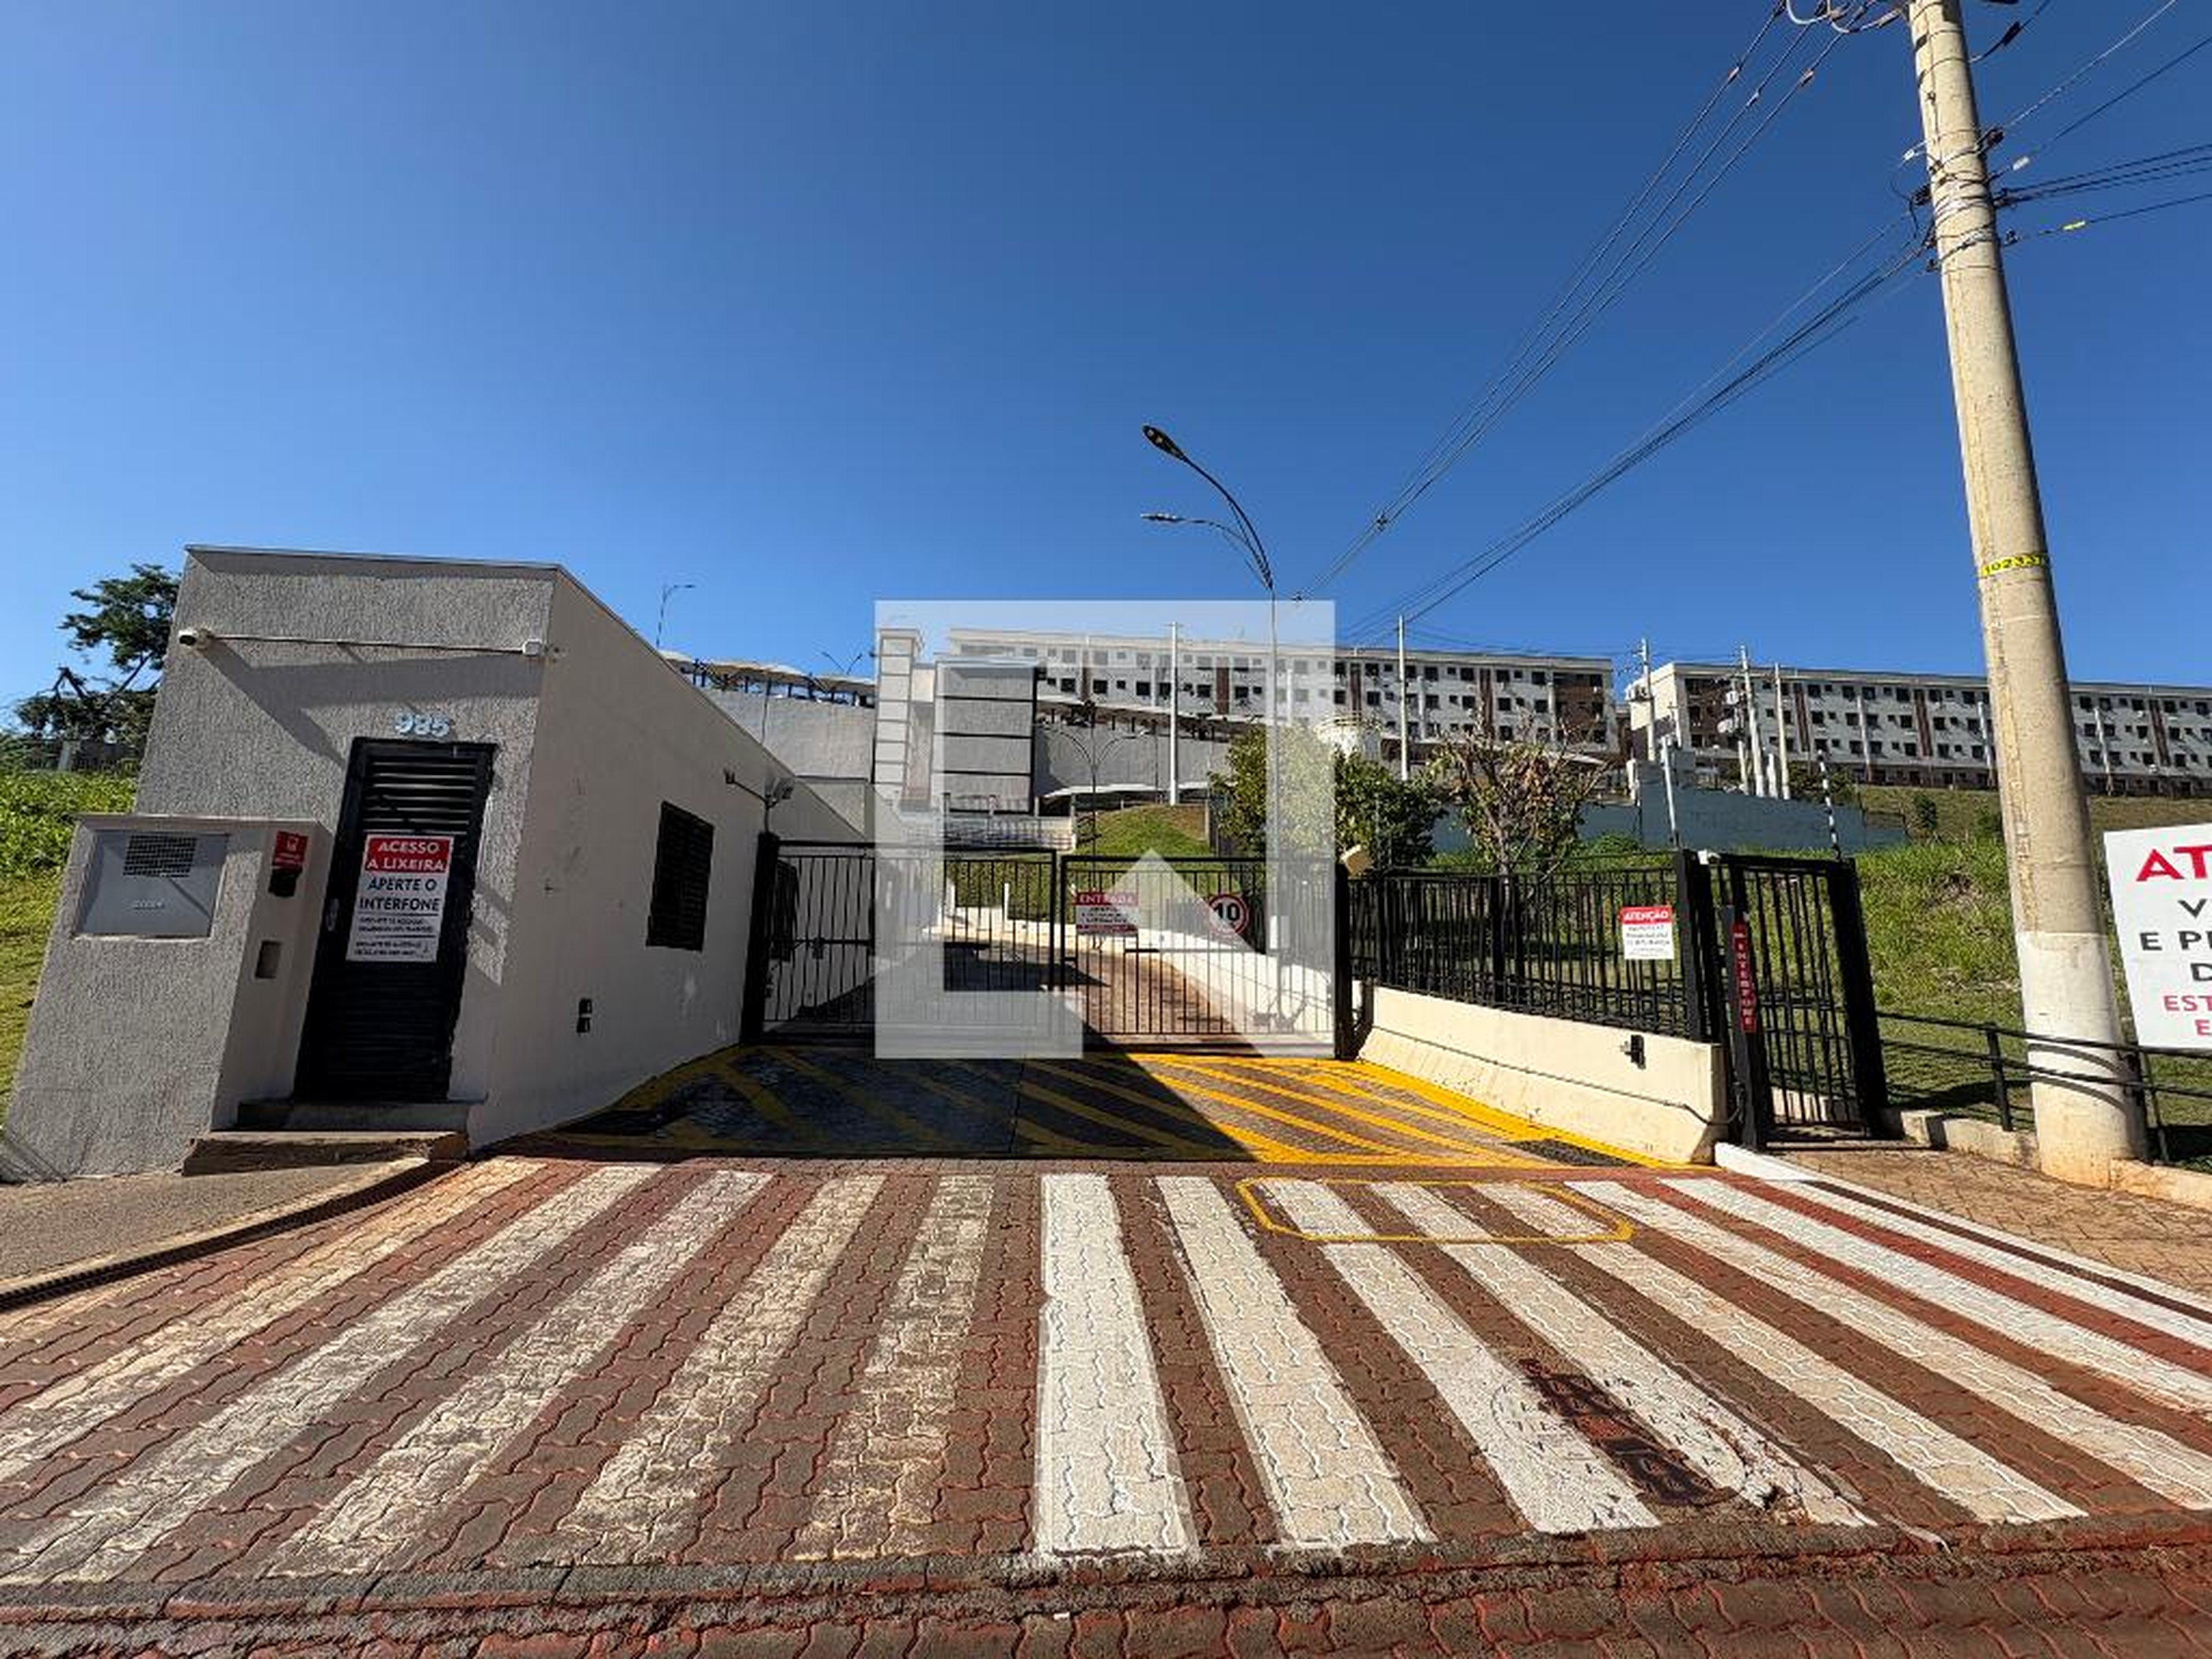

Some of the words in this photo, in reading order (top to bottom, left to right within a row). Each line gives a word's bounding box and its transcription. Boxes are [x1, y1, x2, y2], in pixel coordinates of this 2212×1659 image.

[395, 713, 450, 738] 985
[378, 842, 440, 854] ACESSO
[367, 858, 378, 869] A
[382, 857, 444, 872] LIXEIRA
[2136, 845, 2212, 881] AT
[368, 877, 421, 891] APERTE
[425, 878, 437, 891] O
[359, 897, 440, 912] INTERFONE
[1213, 903, 1240, 921] 10
[1624, 910, 1669, 923] ATENÇÃO
[2139, 932, 2162, 951] E
